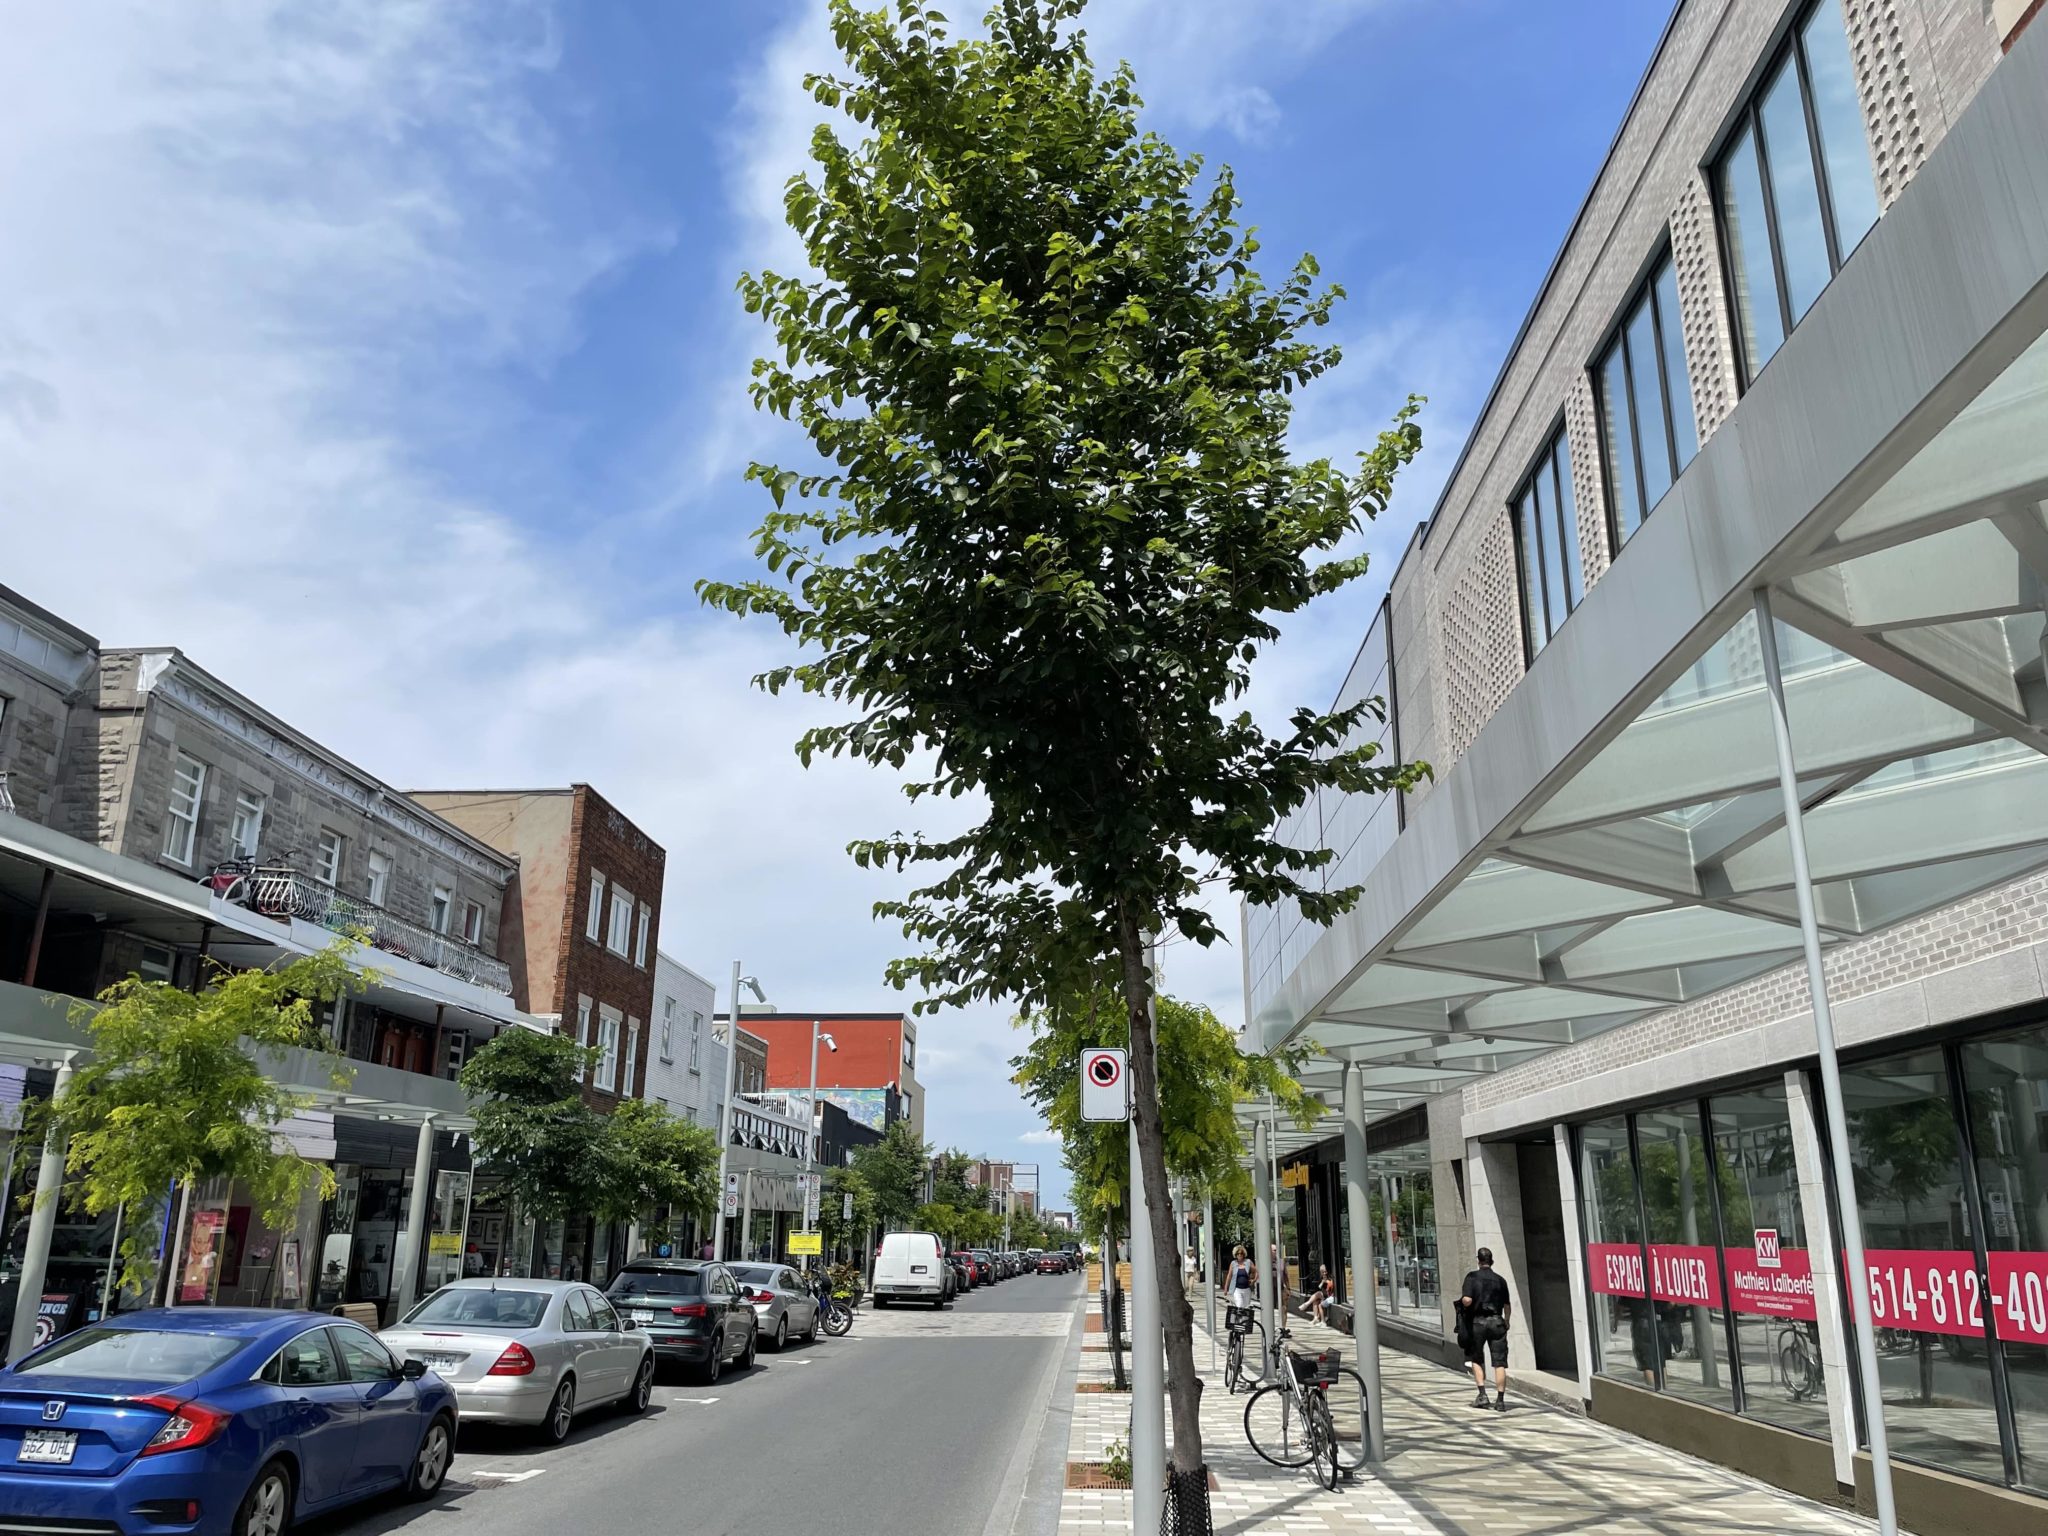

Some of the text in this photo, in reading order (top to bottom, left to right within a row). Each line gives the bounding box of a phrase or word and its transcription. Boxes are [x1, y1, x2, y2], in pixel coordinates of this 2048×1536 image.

[1756, 1237, 1777, 1257] KW
[1652, 1248, 1663, 1294] À
[1664, 1257, 1709, 1300] LOUER
[1734, 1270, 1814, 1296] Mathieu Laliberté
[1869, 1266, 2048, 1334] 514-812-40
[49, 1440, 70, 1456] DHL
